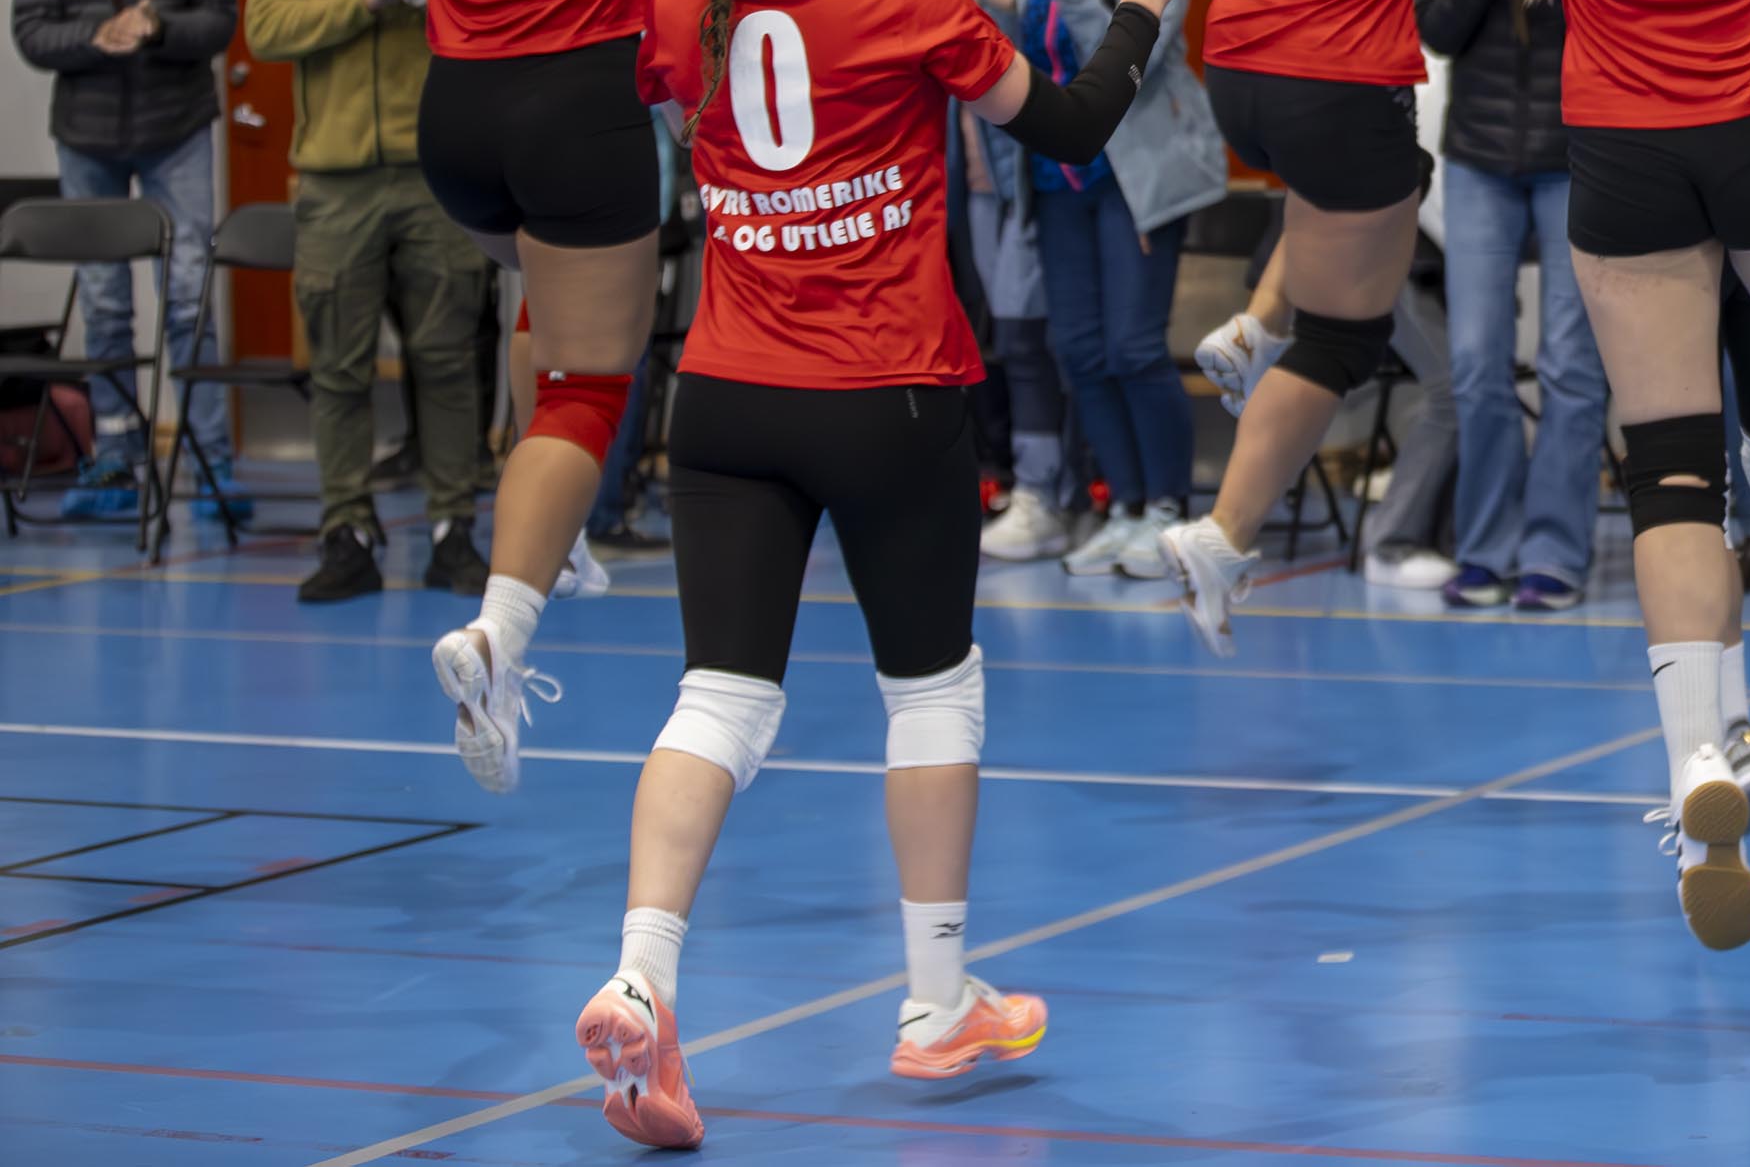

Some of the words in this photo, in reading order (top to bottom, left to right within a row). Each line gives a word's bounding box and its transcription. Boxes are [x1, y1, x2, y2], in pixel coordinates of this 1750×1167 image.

[729, 9, 814, 171] 0
[752, 165, 903, 215] ROMERIKE
[733, 225, 775, 252] OG
[781, 212, 875, 252] UTLEIE
[883, 199, 913, 231] AS
